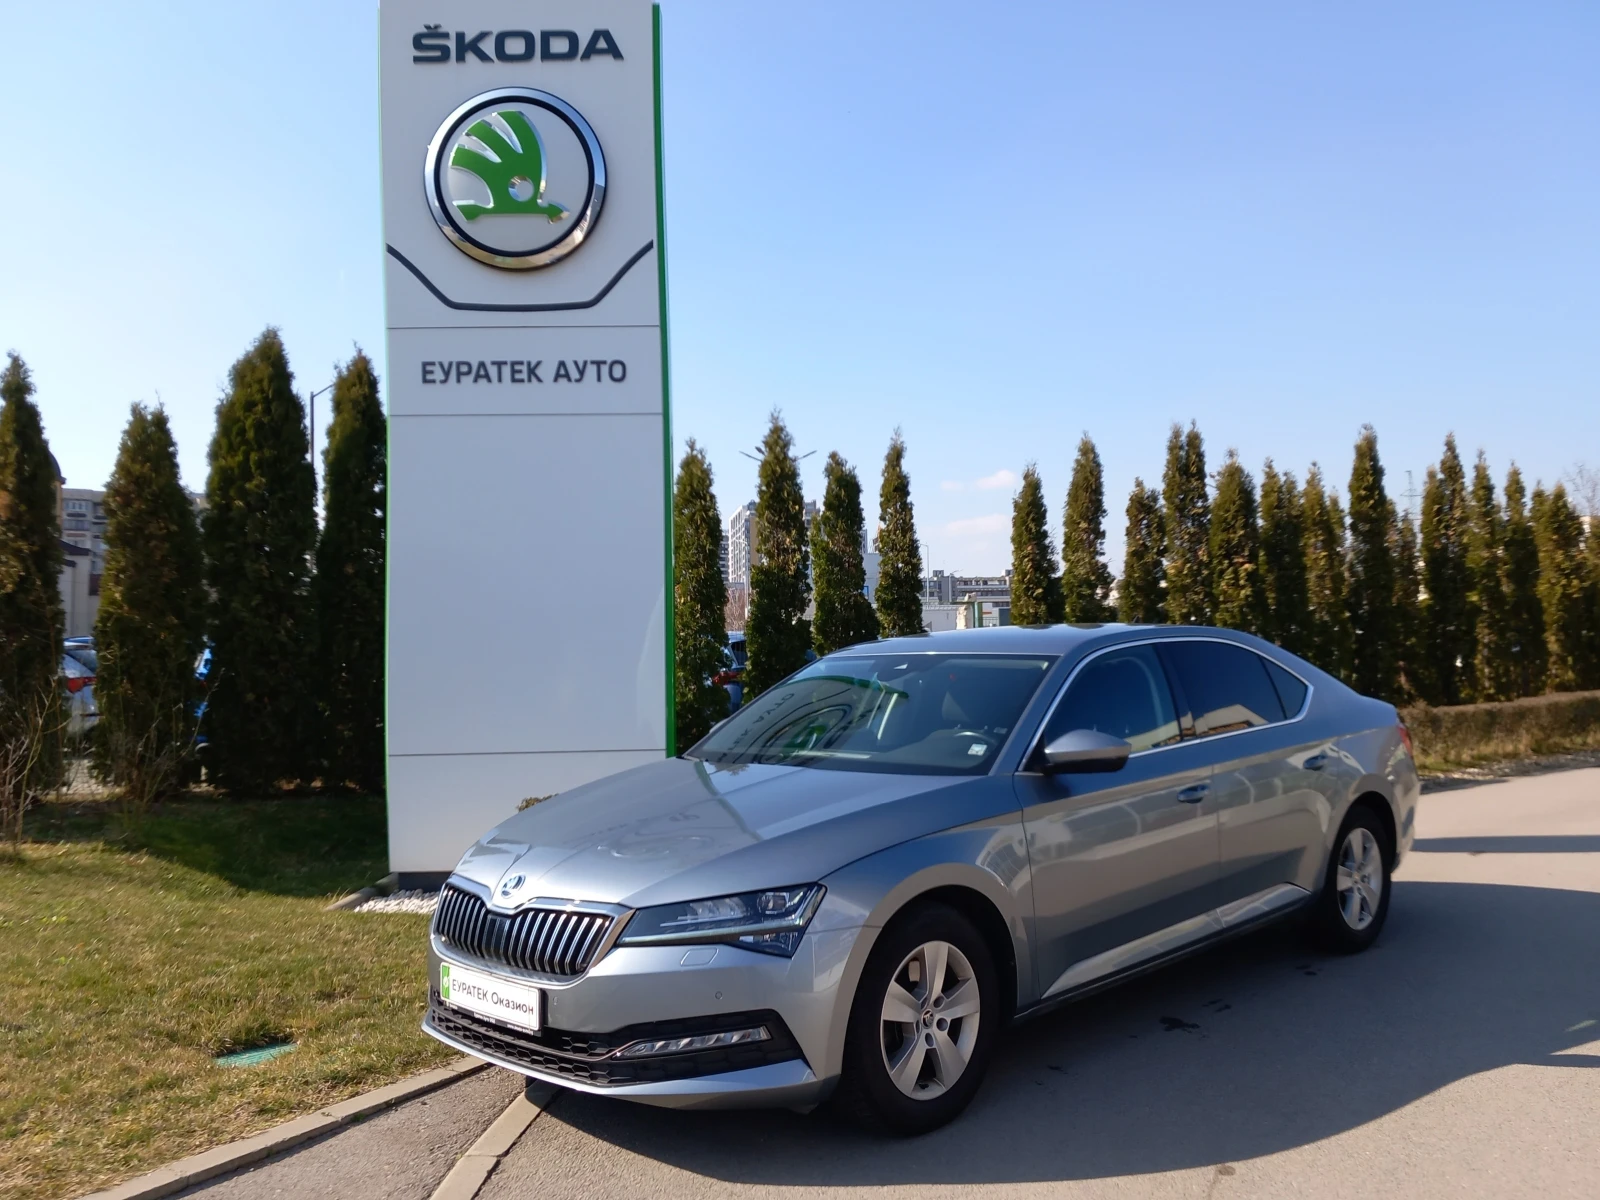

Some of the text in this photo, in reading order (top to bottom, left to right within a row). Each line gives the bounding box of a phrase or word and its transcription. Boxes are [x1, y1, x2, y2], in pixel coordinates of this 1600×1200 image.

[412, 24, 624, 63] ŠKODA
[421, 359, 627, 384] ЕУРАТЕК АУТО
[452, 978, 534, 1016] ЕУРАТЕК Оказион
